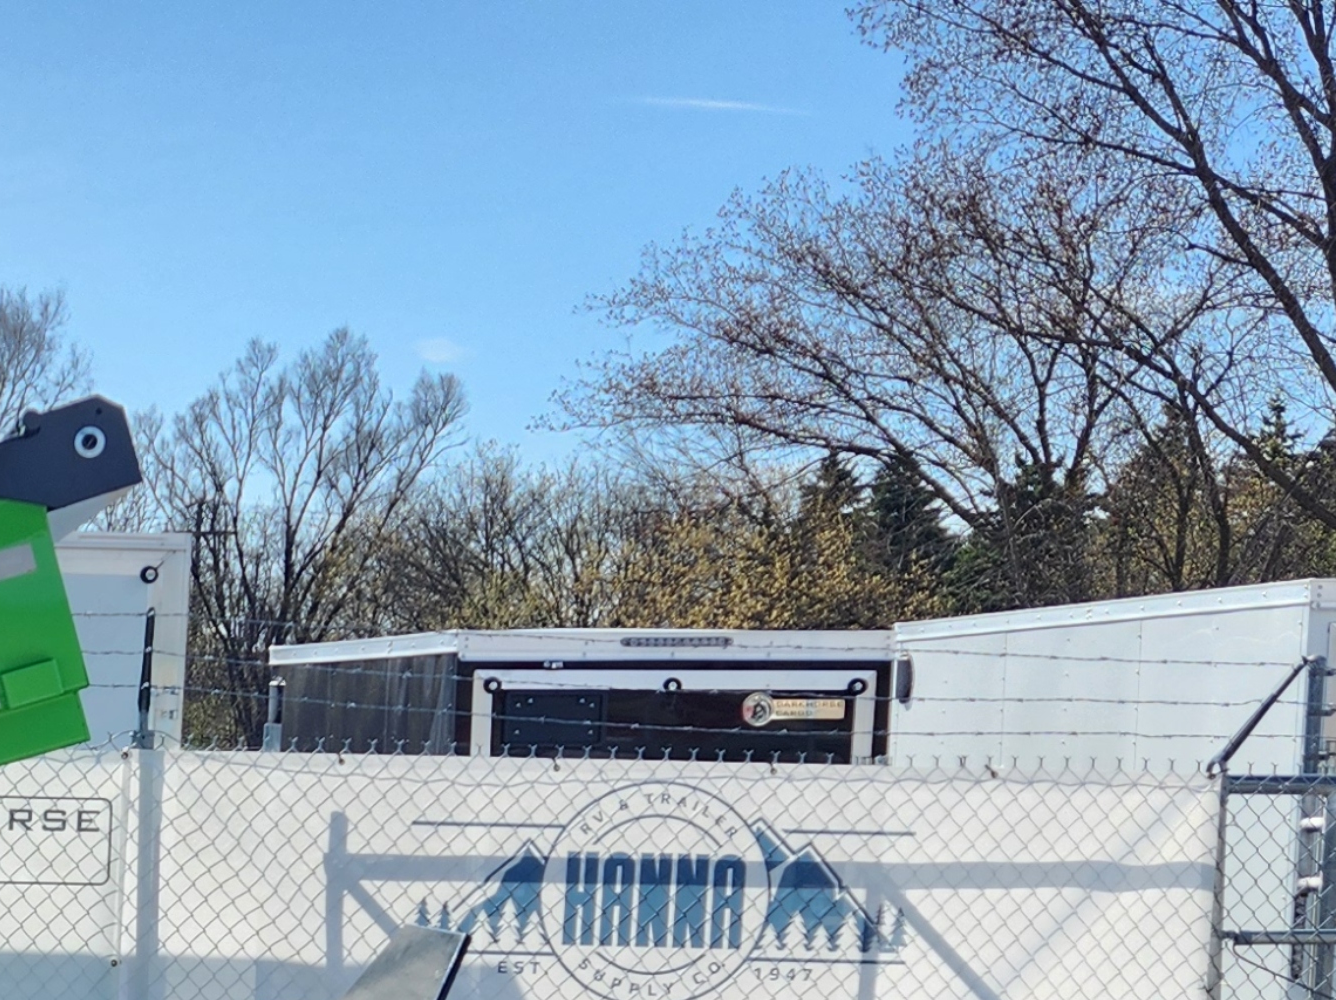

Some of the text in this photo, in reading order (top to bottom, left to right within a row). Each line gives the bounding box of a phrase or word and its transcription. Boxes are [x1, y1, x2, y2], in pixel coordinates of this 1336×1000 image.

[579, 810, 605, 835] RV
[644, 792, 739, 838] TRAILER
[562, 850, 747, 950] HANNA
[578, 959, 675, 997] SUPPLY
[754, 967, 813, 981] 1947
